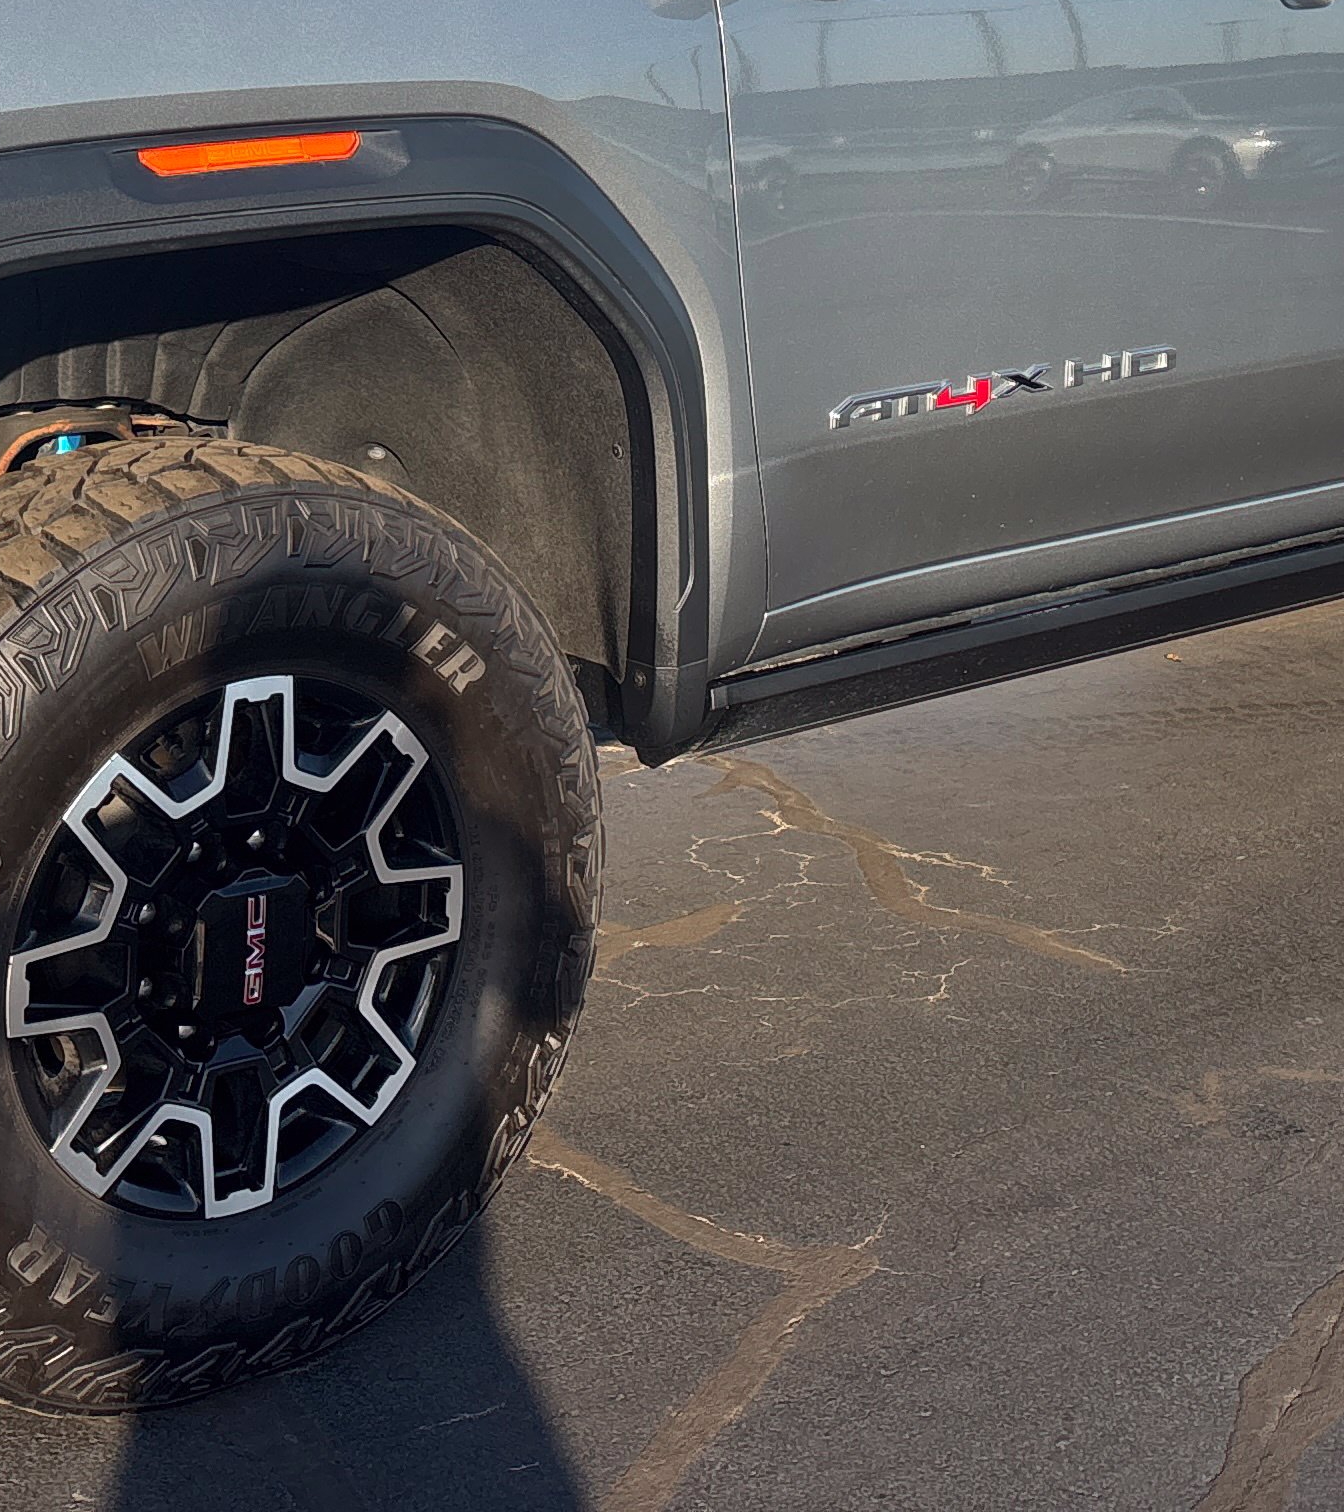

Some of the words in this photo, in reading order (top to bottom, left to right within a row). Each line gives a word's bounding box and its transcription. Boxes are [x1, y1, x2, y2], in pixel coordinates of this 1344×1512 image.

[828, 363, 1054, 430] AT4X
[1064, 343, 1177, 388] HD
[135, 584, 487, 696] WRANGLER
[242, 894, 267, 1005] GMC
[6, 1198, 404, 1340] GOODYEAR
